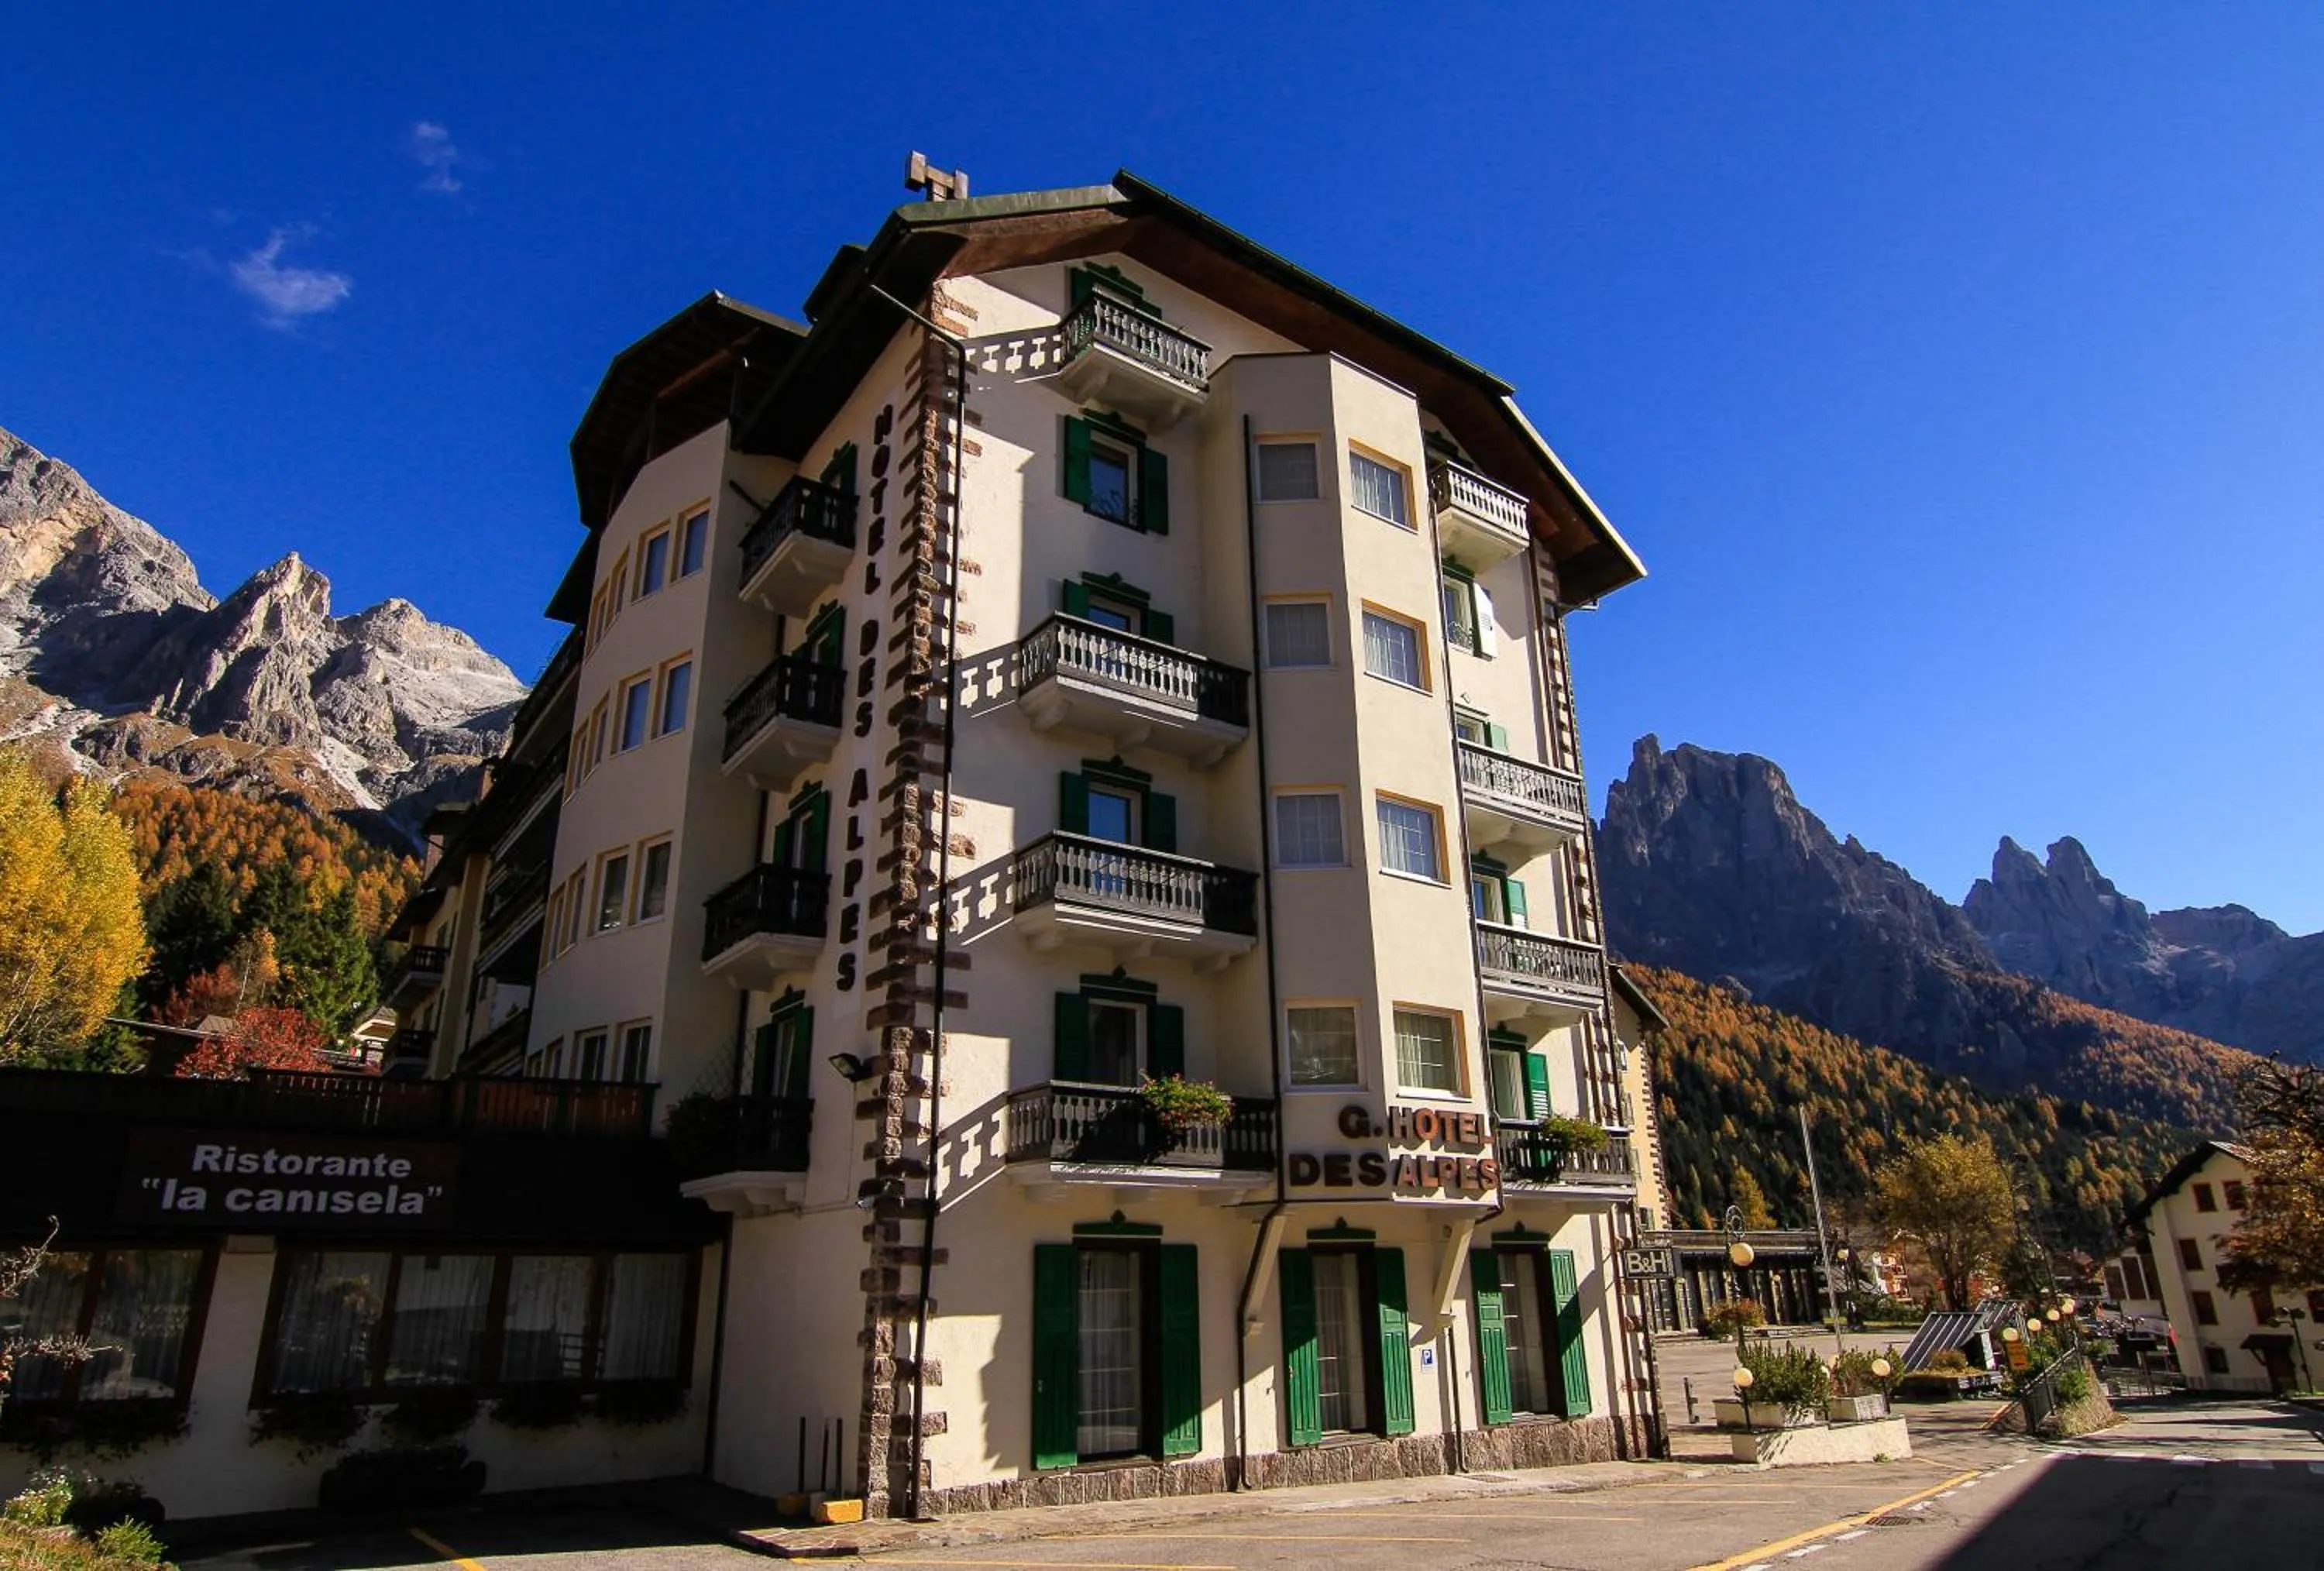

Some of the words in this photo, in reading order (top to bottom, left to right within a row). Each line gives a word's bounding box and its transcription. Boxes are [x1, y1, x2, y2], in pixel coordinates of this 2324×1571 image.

[865, 404, 893, 595] HOTEL
[855, 619, 878, 737] DES
[837, 768, 868, 992] ALPES
[191, 1144, 413, 1178] Ristorante
[1338, 1105, 1384, 1139] G.
[1389, 1105, 1496, 1144] HOTEL
[1288, 1152, 1387, 1187] DES
[1393, 1153, 1501, 1190] ALPES
